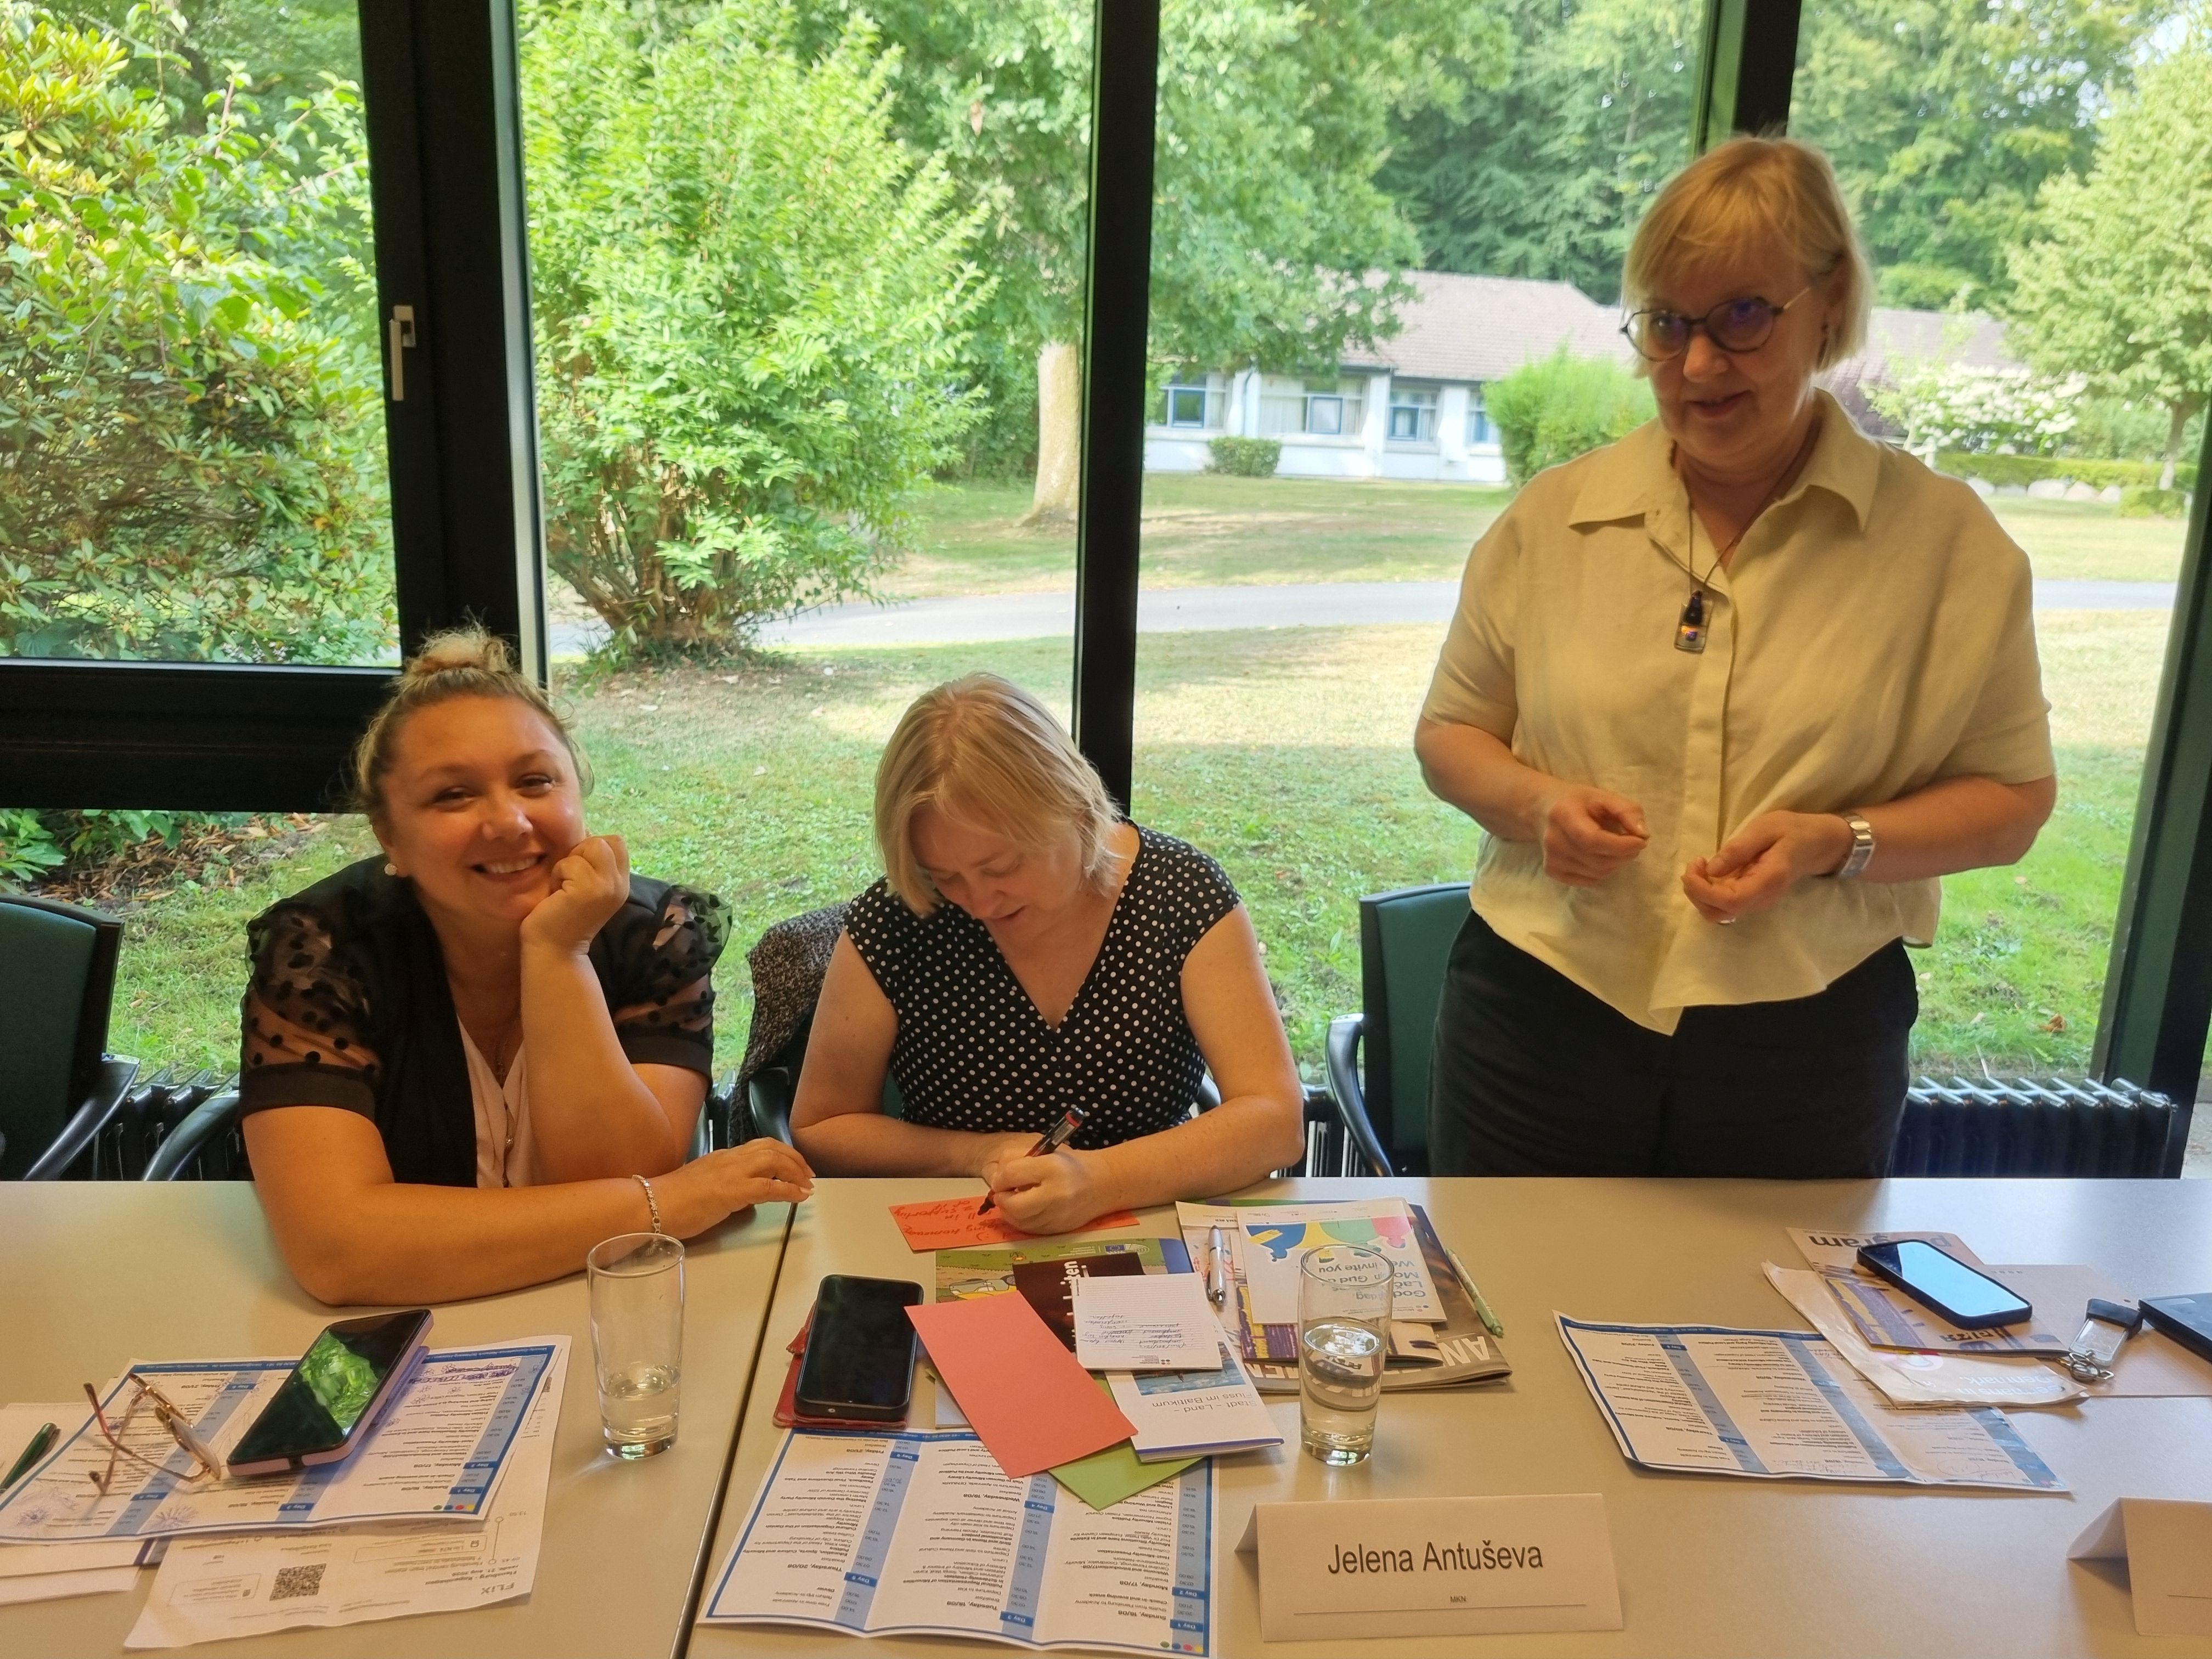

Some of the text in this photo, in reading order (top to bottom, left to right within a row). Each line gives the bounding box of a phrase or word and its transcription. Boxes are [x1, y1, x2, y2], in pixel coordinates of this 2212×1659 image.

[1808, 1233, 1953, 1248] pgram
[1319, 1264, 1342, 1273] you
[1345, 1262, 1378, 1270] invite
[1152, 1397, 1203, 1408] Baltikum
[1183, 1404, 1213, 1413] Land
[983, 1494, 1020, 1502] Wednesday,
[1328, 1540, 1543, 1574] Jelena Antuševa
[810, 1564, 842, 1572] Thursday,
[479, 1570, 517, 1579] Flensburg
[1139, 1582, 1168, 1590] Monday,
[968, 1601, 998, 1611] Tuesday,
[1139, 1611, 1166, 1620] Sunday,
